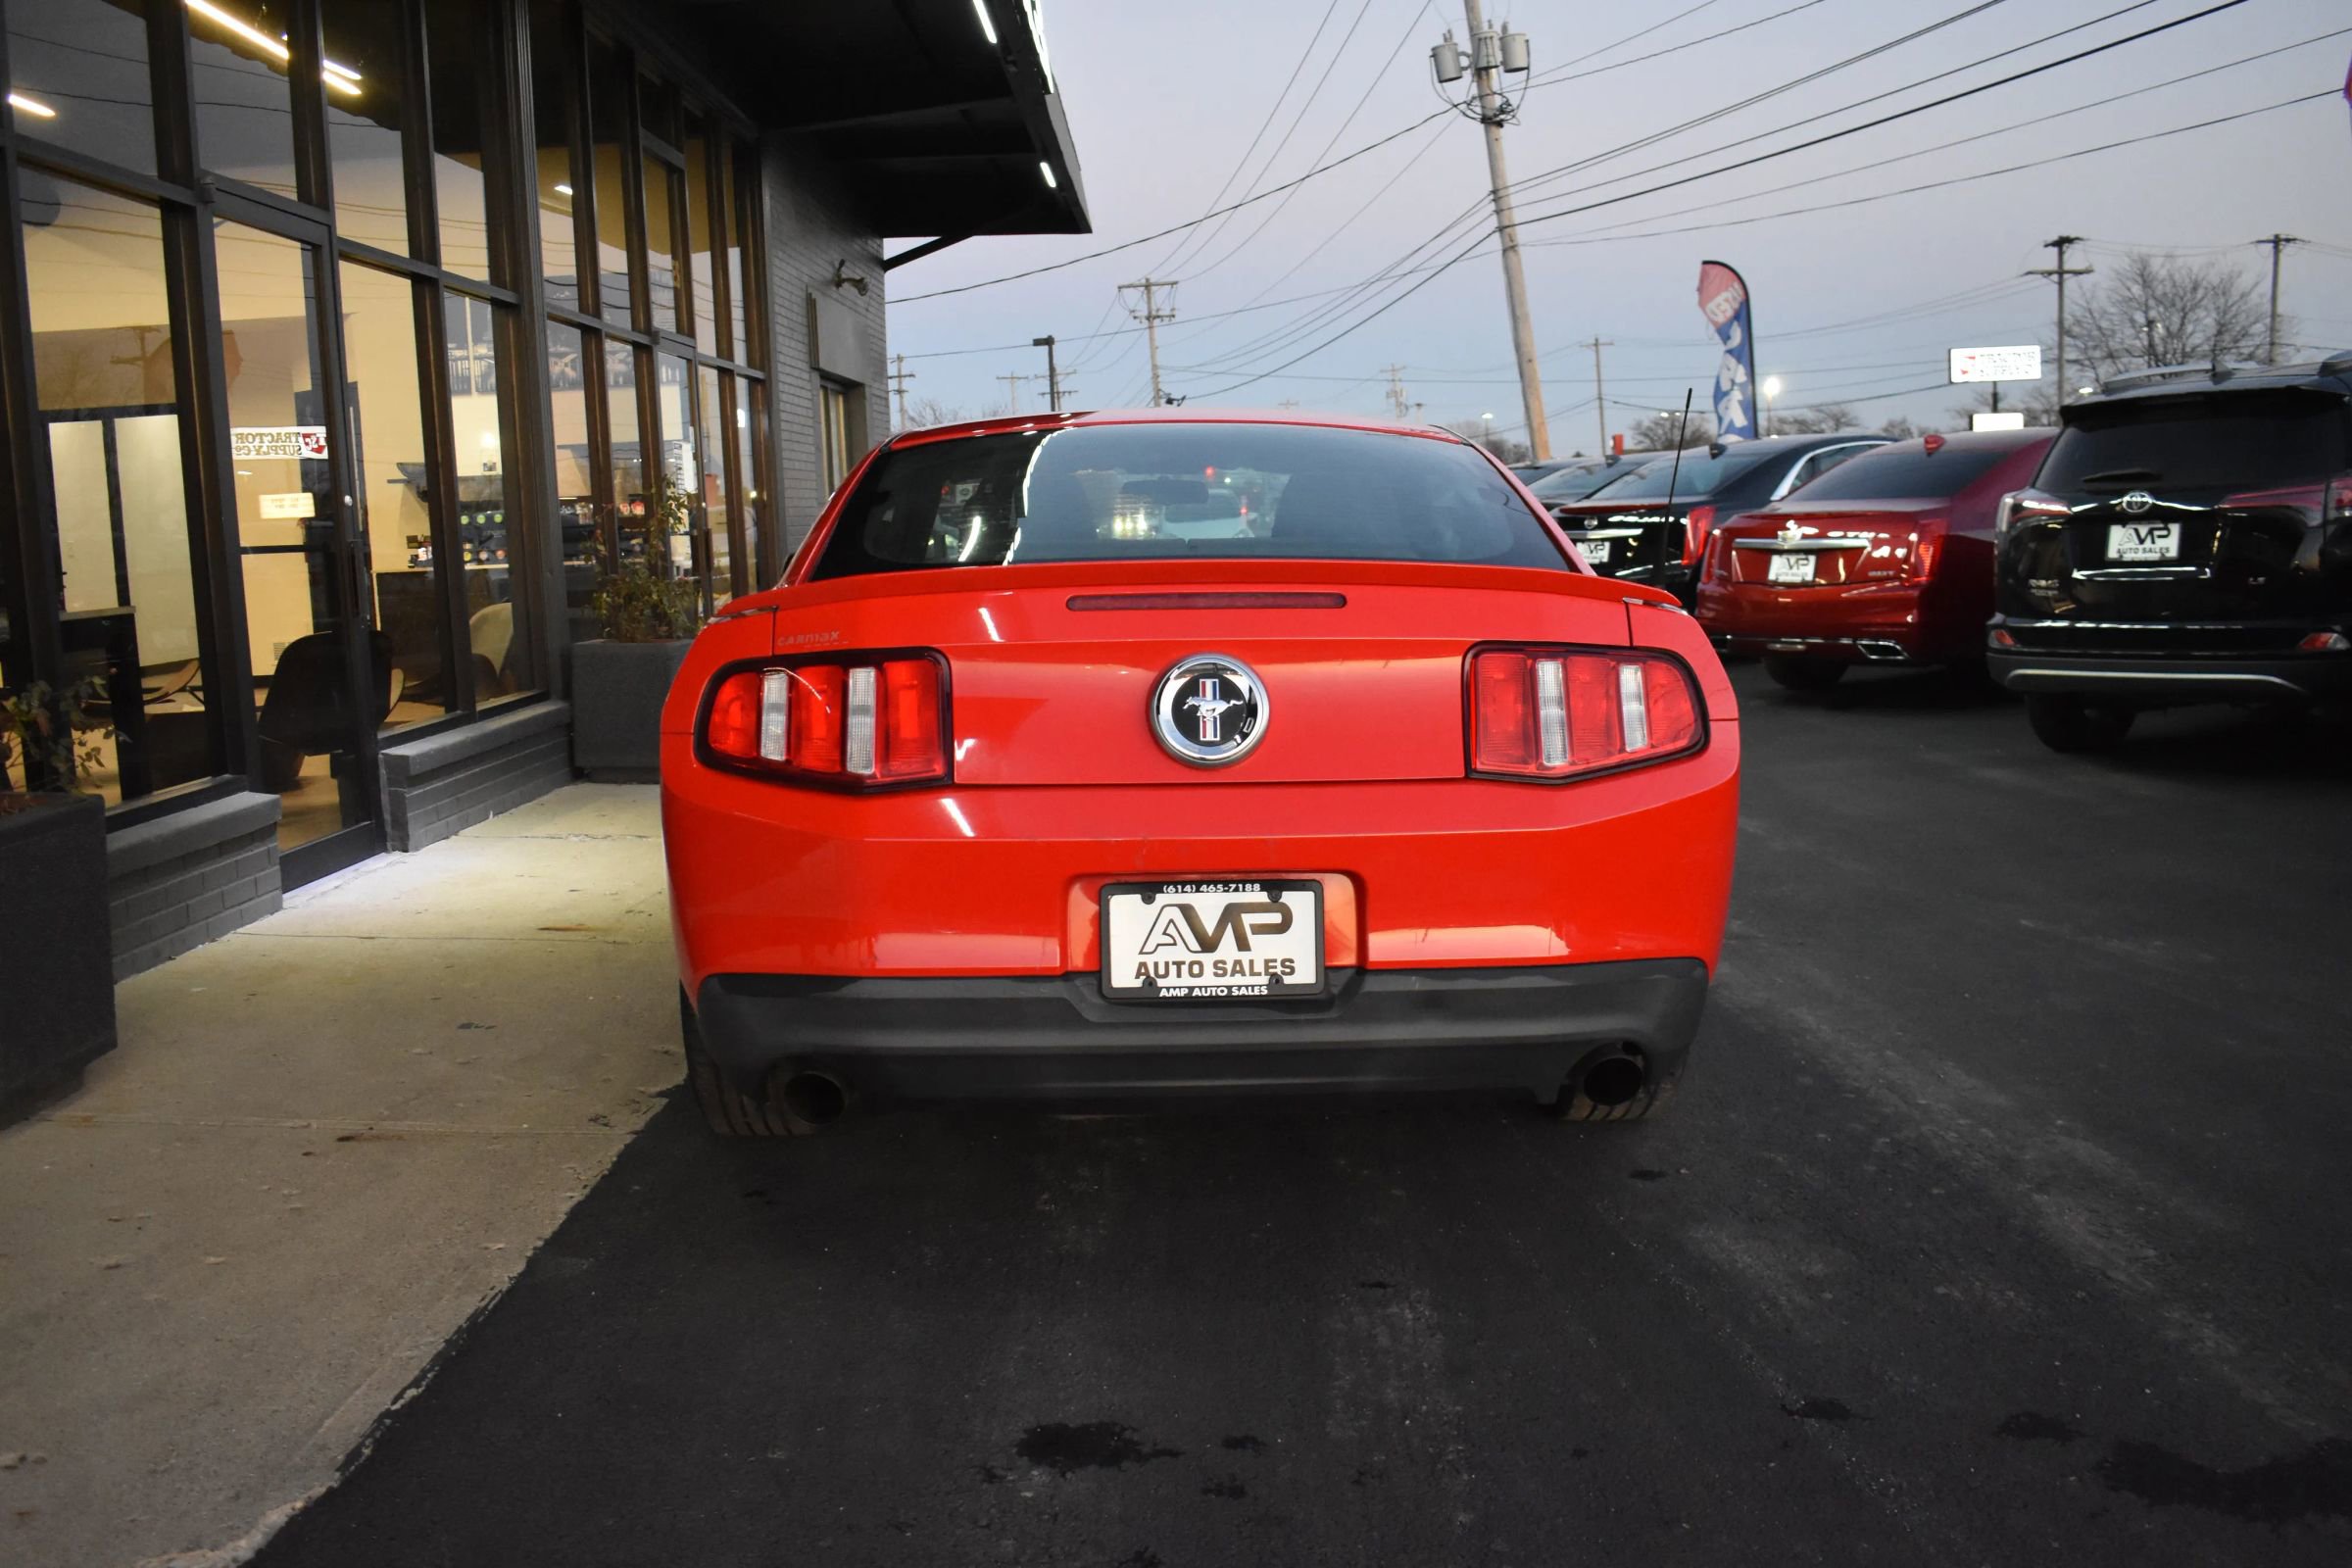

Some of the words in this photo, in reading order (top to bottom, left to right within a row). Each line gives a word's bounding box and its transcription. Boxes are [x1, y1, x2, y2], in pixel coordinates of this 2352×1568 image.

[1163, 884, 1196, 894] (614)
[1200, 883, 1260, 893] 465-7188
[1135, 960, 1204, 979] AUTO
[1212, 957, 1296, 977] SALES
[1159, 987, 1189, 998] AMP
[1192, 986, 1228, 997] AUTO
[1231, 985, 1268, 996] SALES
